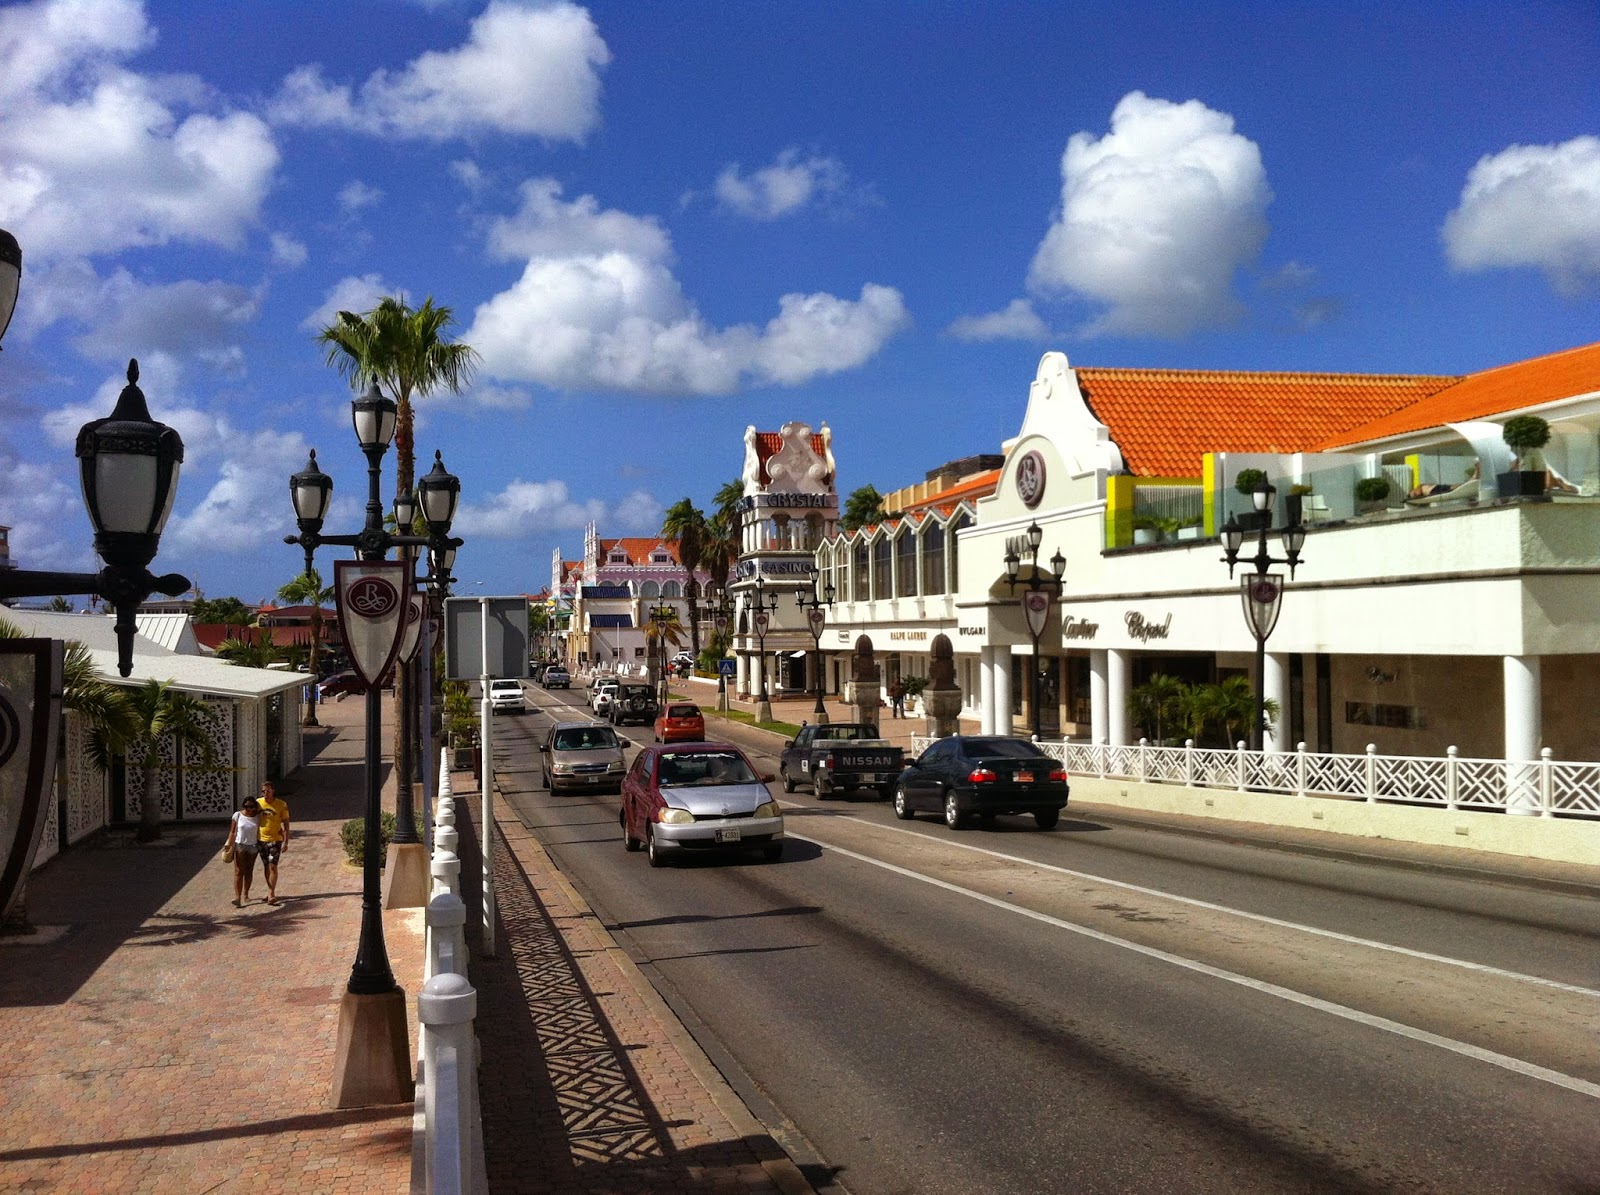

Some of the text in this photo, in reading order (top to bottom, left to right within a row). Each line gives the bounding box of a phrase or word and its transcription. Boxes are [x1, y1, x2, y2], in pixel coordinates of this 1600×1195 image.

[767, 493, 831, 508] CRYSTAL
[762, 561, 813, 574] CASINO
[959, 627, 986, 636] BVLGARI
[842, 757, 892, 766] NISSAN
